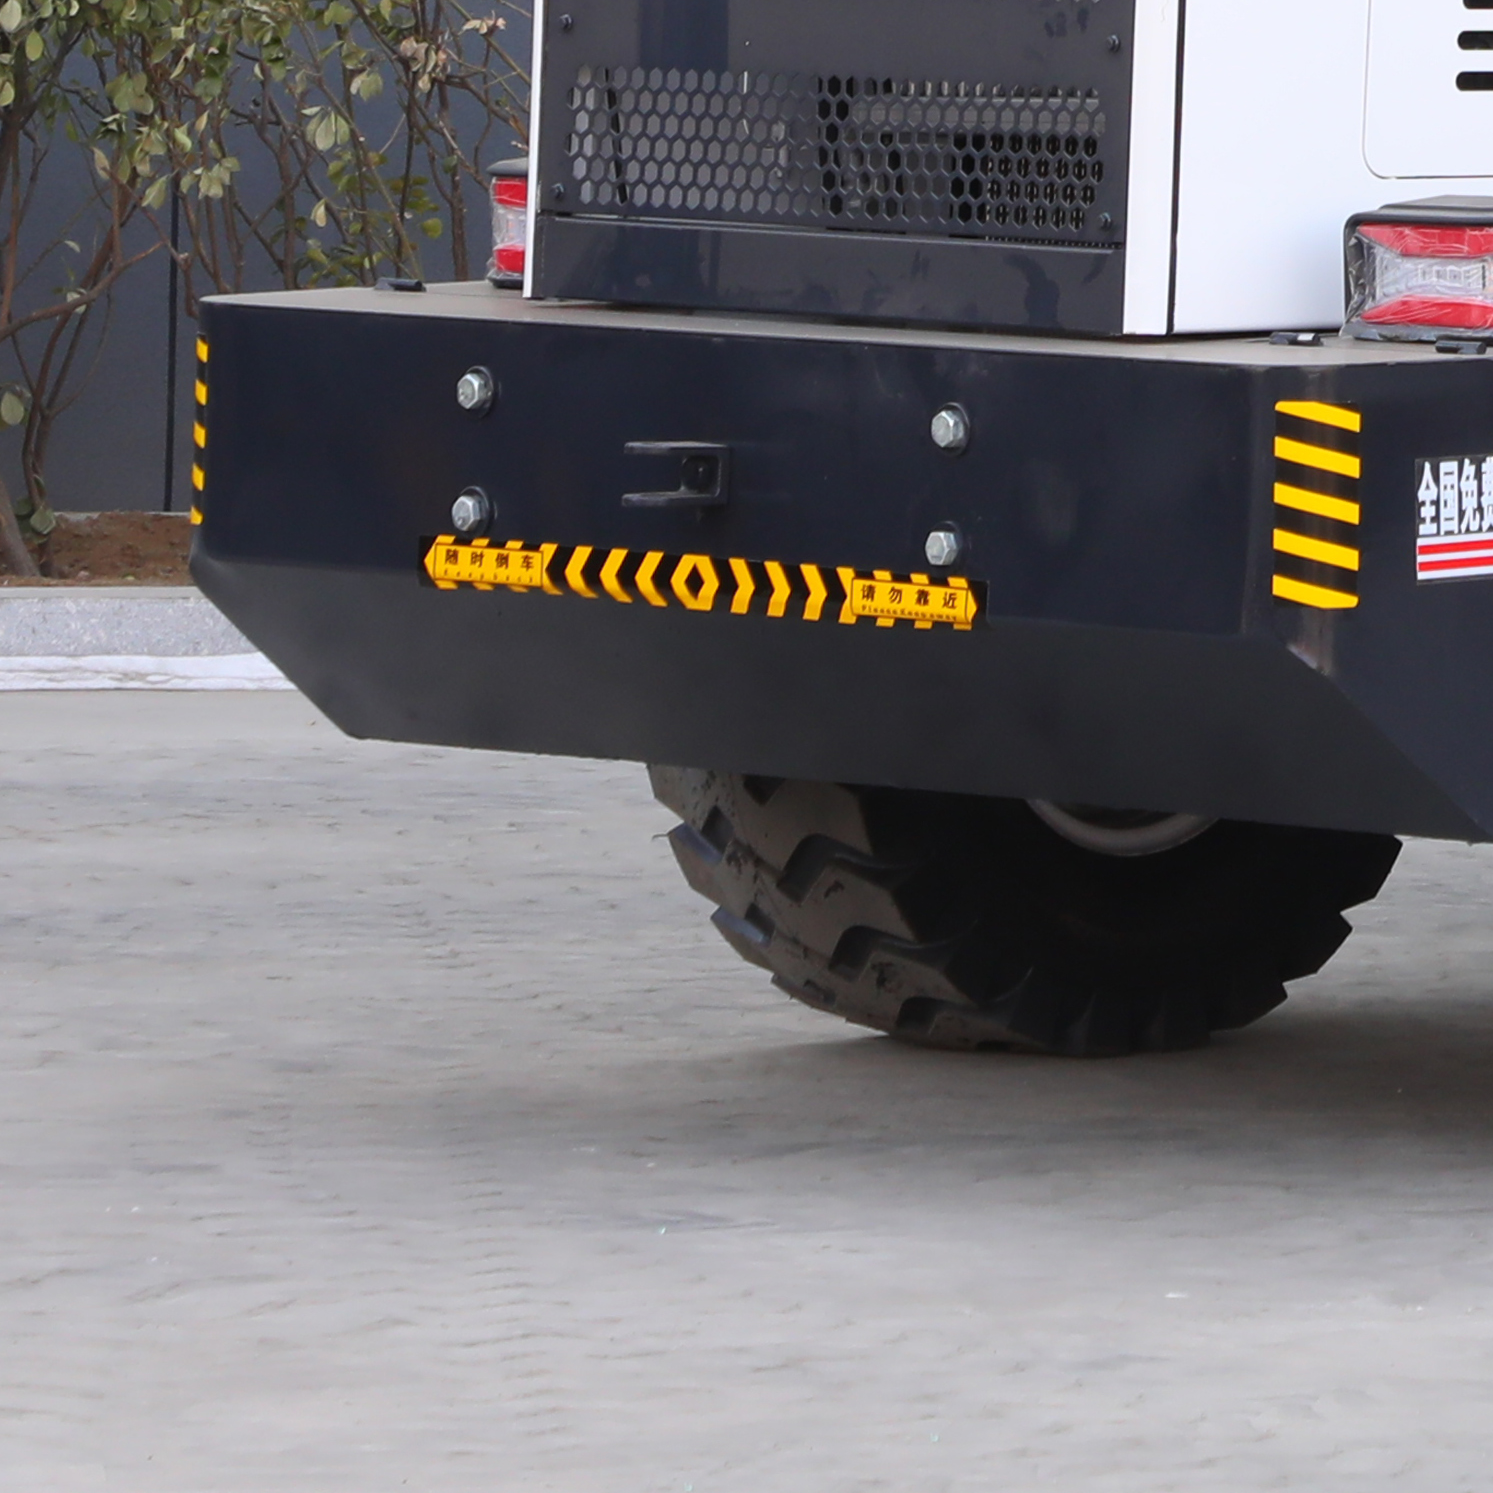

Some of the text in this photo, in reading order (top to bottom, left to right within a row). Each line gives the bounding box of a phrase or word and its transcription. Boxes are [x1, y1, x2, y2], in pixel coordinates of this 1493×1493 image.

[444, 548, 535, 573] 随时倒车
[860, 584, 958, 609] 请勿靠近
